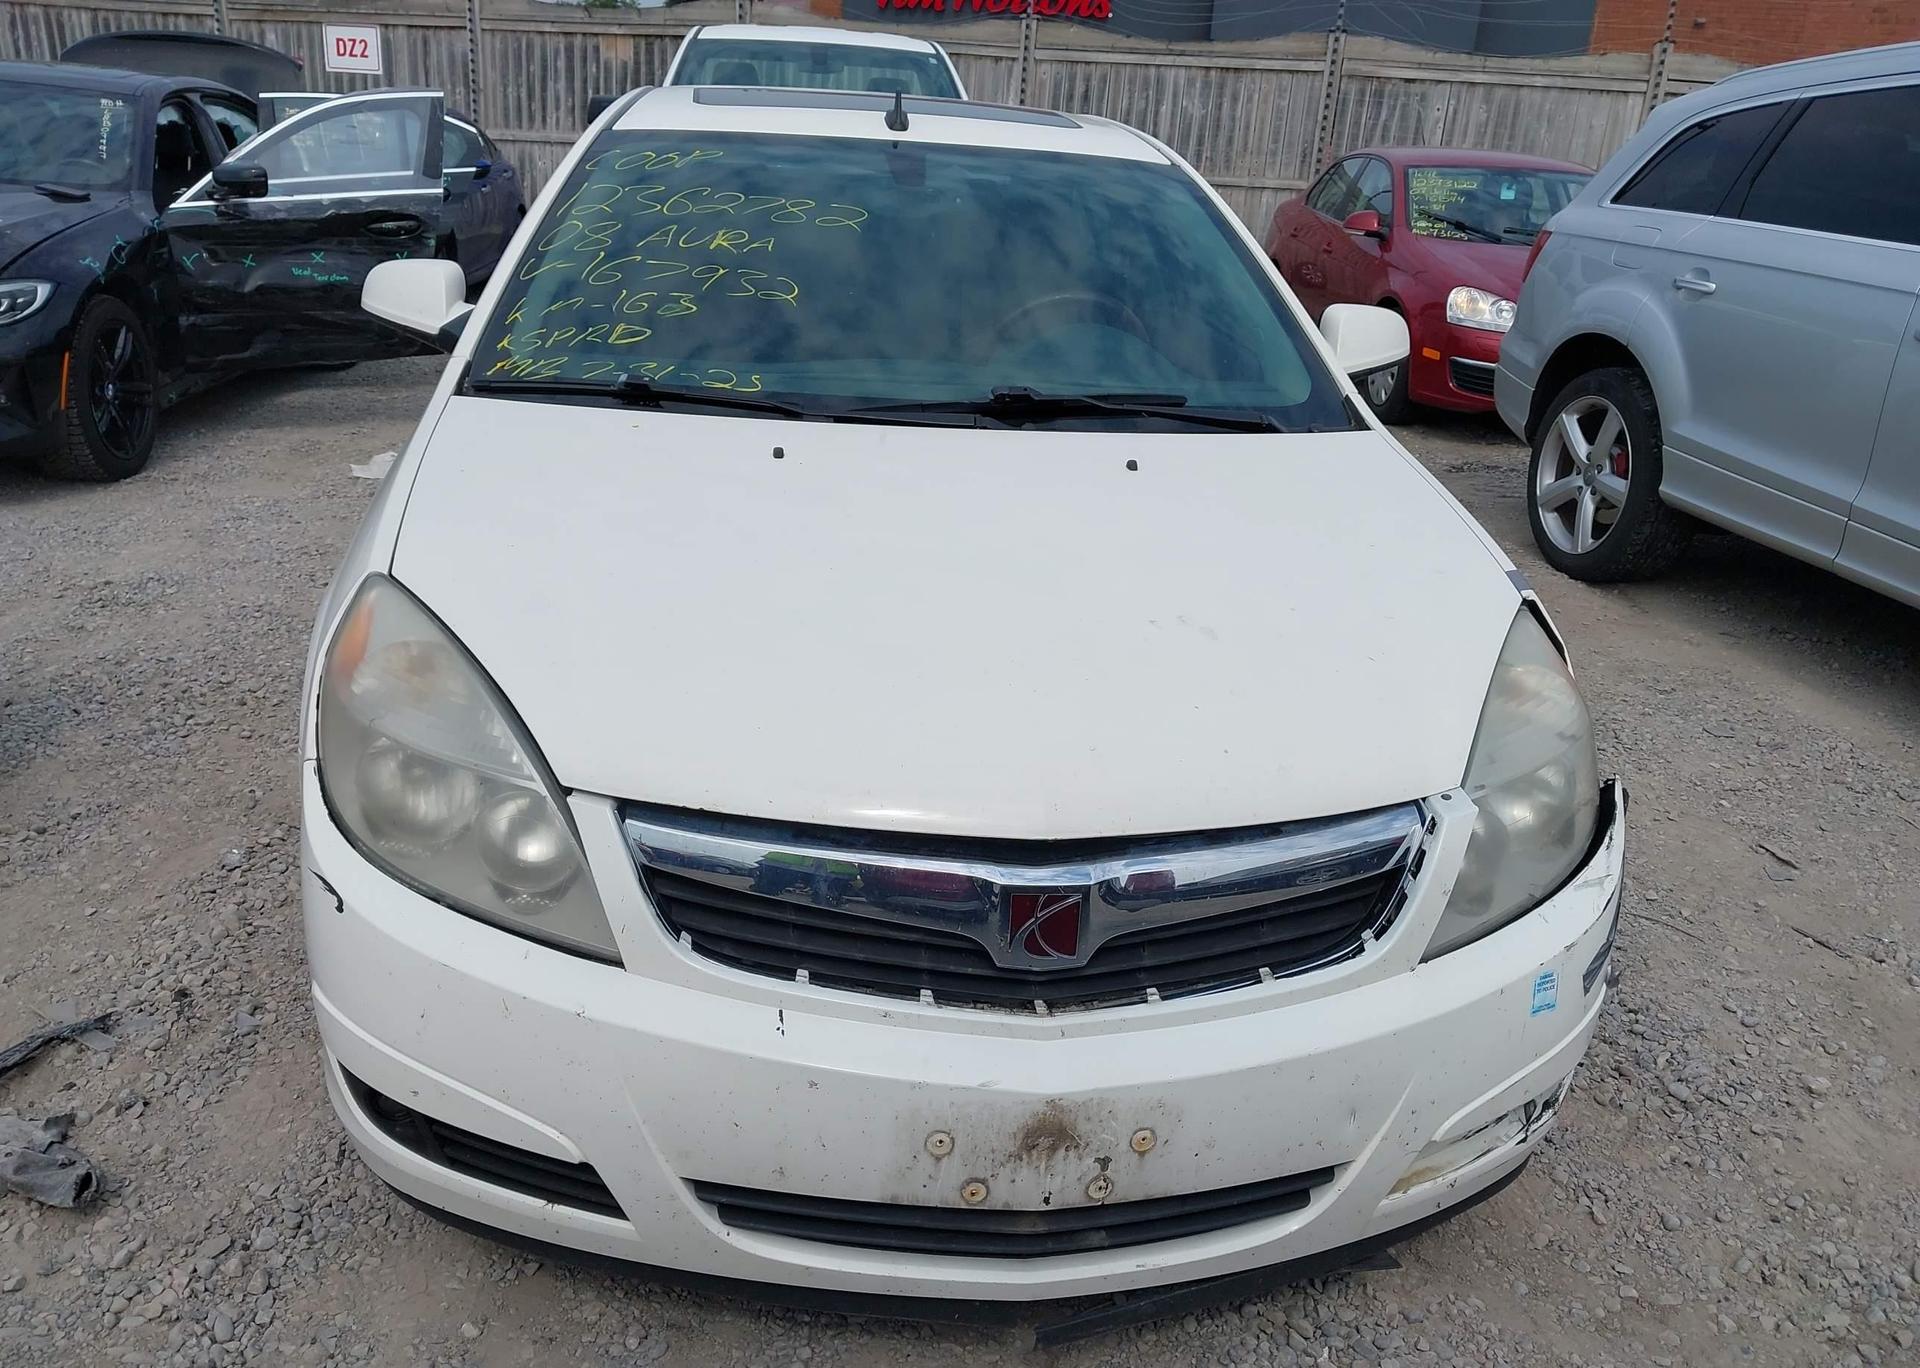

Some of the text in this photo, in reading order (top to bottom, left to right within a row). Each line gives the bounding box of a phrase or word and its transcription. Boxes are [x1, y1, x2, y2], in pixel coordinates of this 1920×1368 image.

[336, 37, 369, 58] DZ2
[585, 150, 724, 170] COOP
[556, 182, 869, 232] 12362782
[537, 220, 775, 254] 08 AURA
